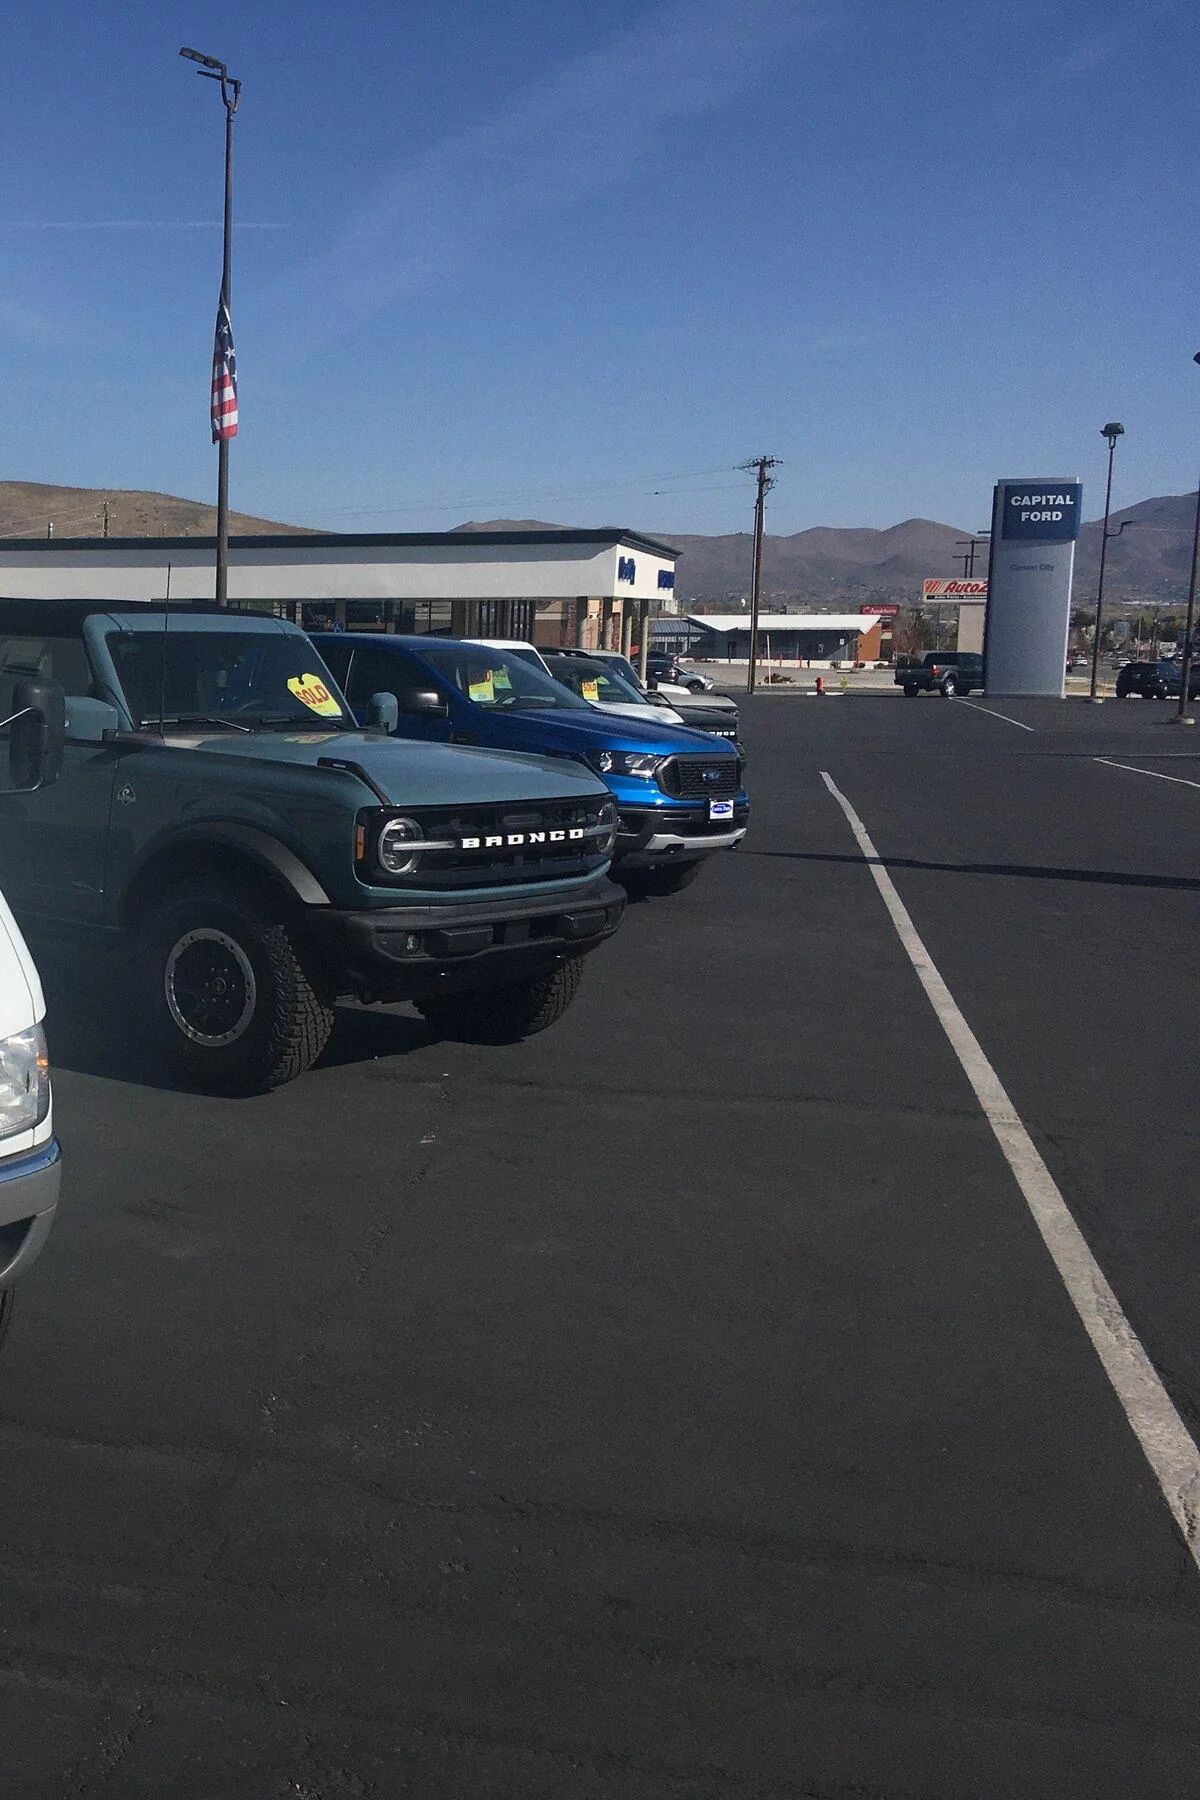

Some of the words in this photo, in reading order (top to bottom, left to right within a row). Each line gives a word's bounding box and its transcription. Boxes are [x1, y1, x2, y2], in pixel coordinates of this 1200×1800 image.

[1010, 494, 1074, 506] CAPITAL
[1021, 511, 1063, 522] FORD
[295, 684, 330, 705] SOLD
[461, 828, 584, 849] BRONCO
